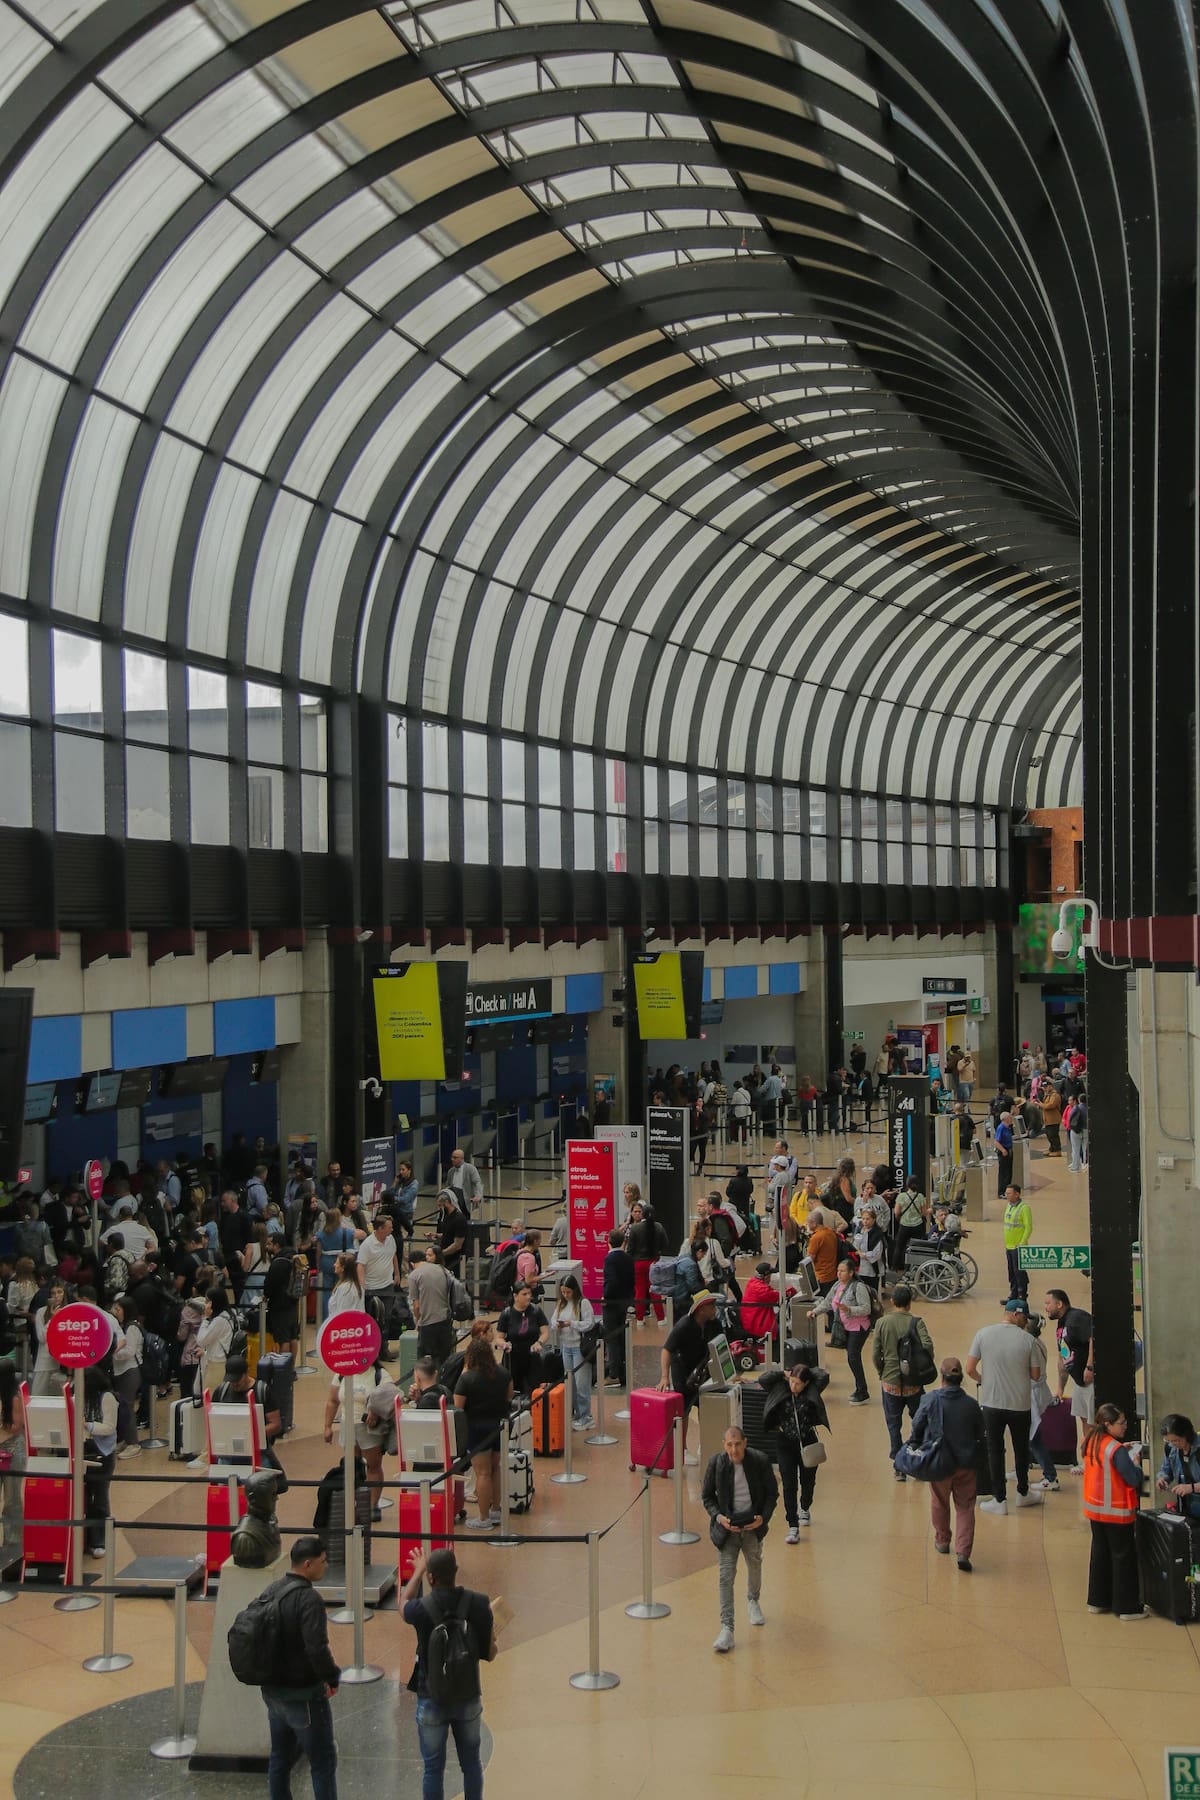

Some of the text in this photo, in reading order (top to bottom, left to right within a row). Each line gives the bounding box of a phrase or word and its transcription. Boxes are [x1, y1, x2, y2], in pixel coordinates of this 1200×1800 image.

[475, 994, 499, 1013] Check
[500, 994, 507, 1011] in
[512, 992, 527, 1009] Hall
[527, 987, 537, 1010] A
[570, 1173, 600, 1181] servicios
[1021, 1248, 1057, 1258] RUTA
[57, 1318, 99, 1334] step 1
[330, 1323, 372, 1343] paso 1
[1175, 1783, 1191, 1793] DE
